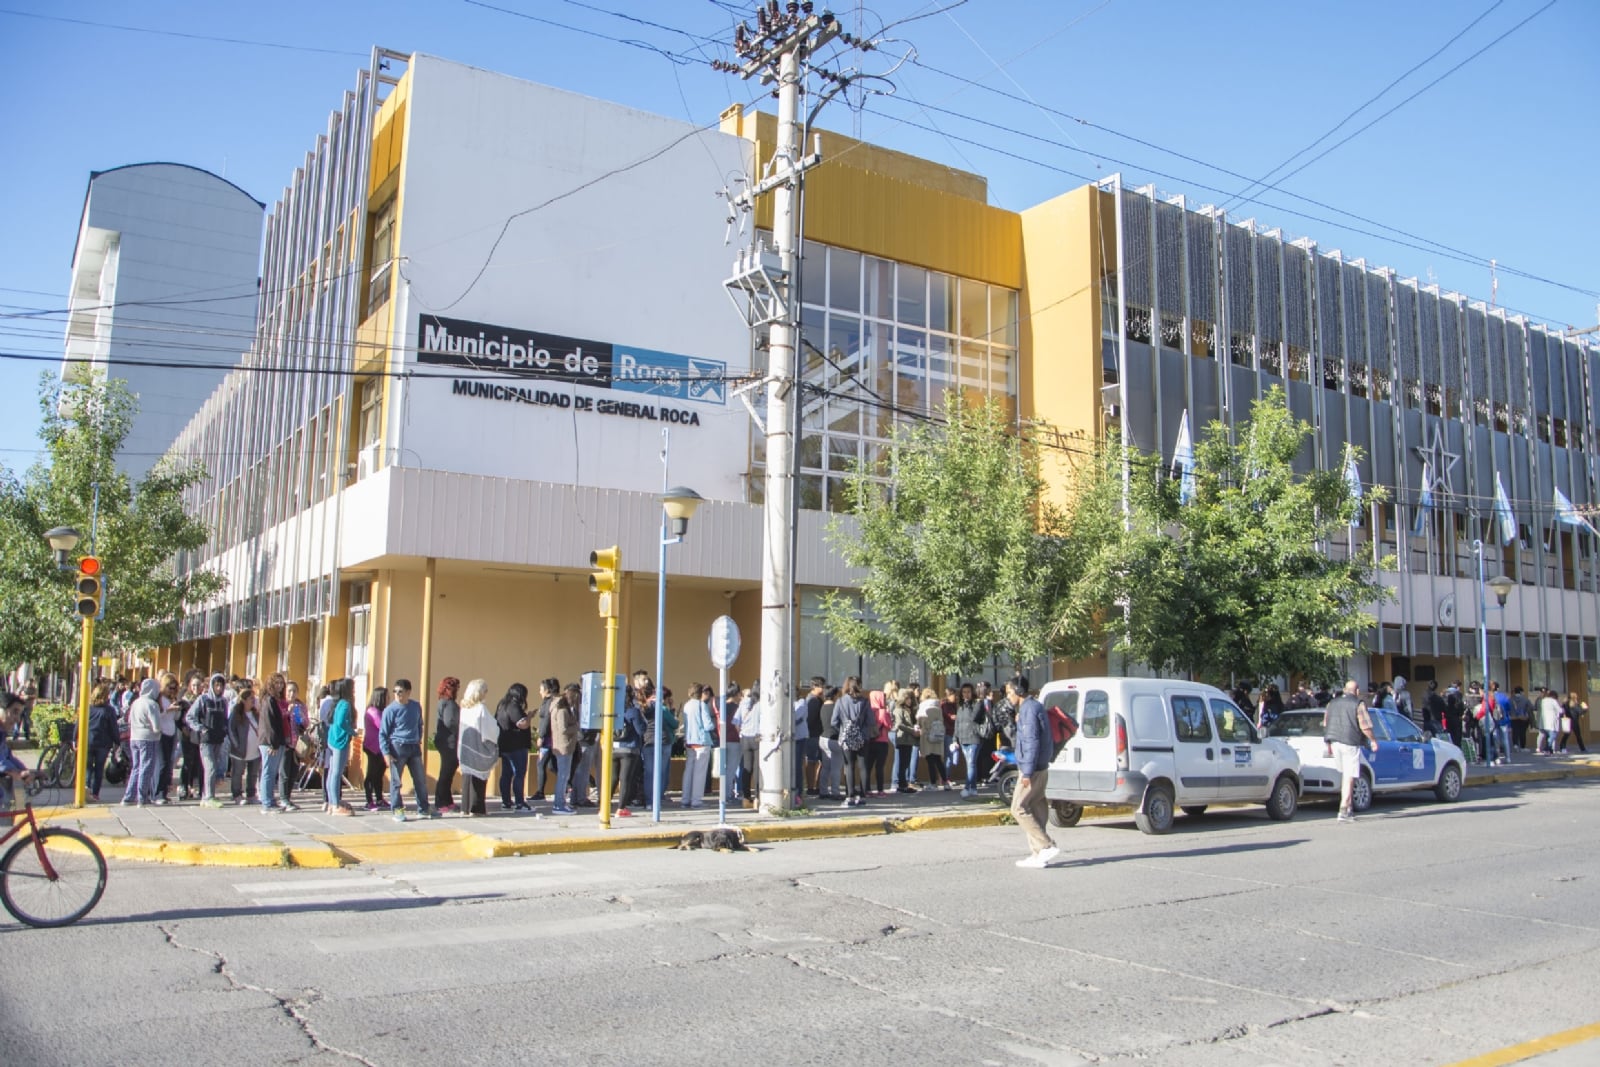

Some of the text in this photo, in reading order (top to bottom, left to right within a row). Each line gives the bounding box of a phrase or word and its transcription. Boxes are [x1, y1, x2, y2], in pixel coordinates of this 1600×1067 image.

[425, 324, 550, 368] Municipio
[564, 347, 599, 375] de
[452, 379, 700, 426] MUNICIPALIDAD DE GENERAL ROCA
